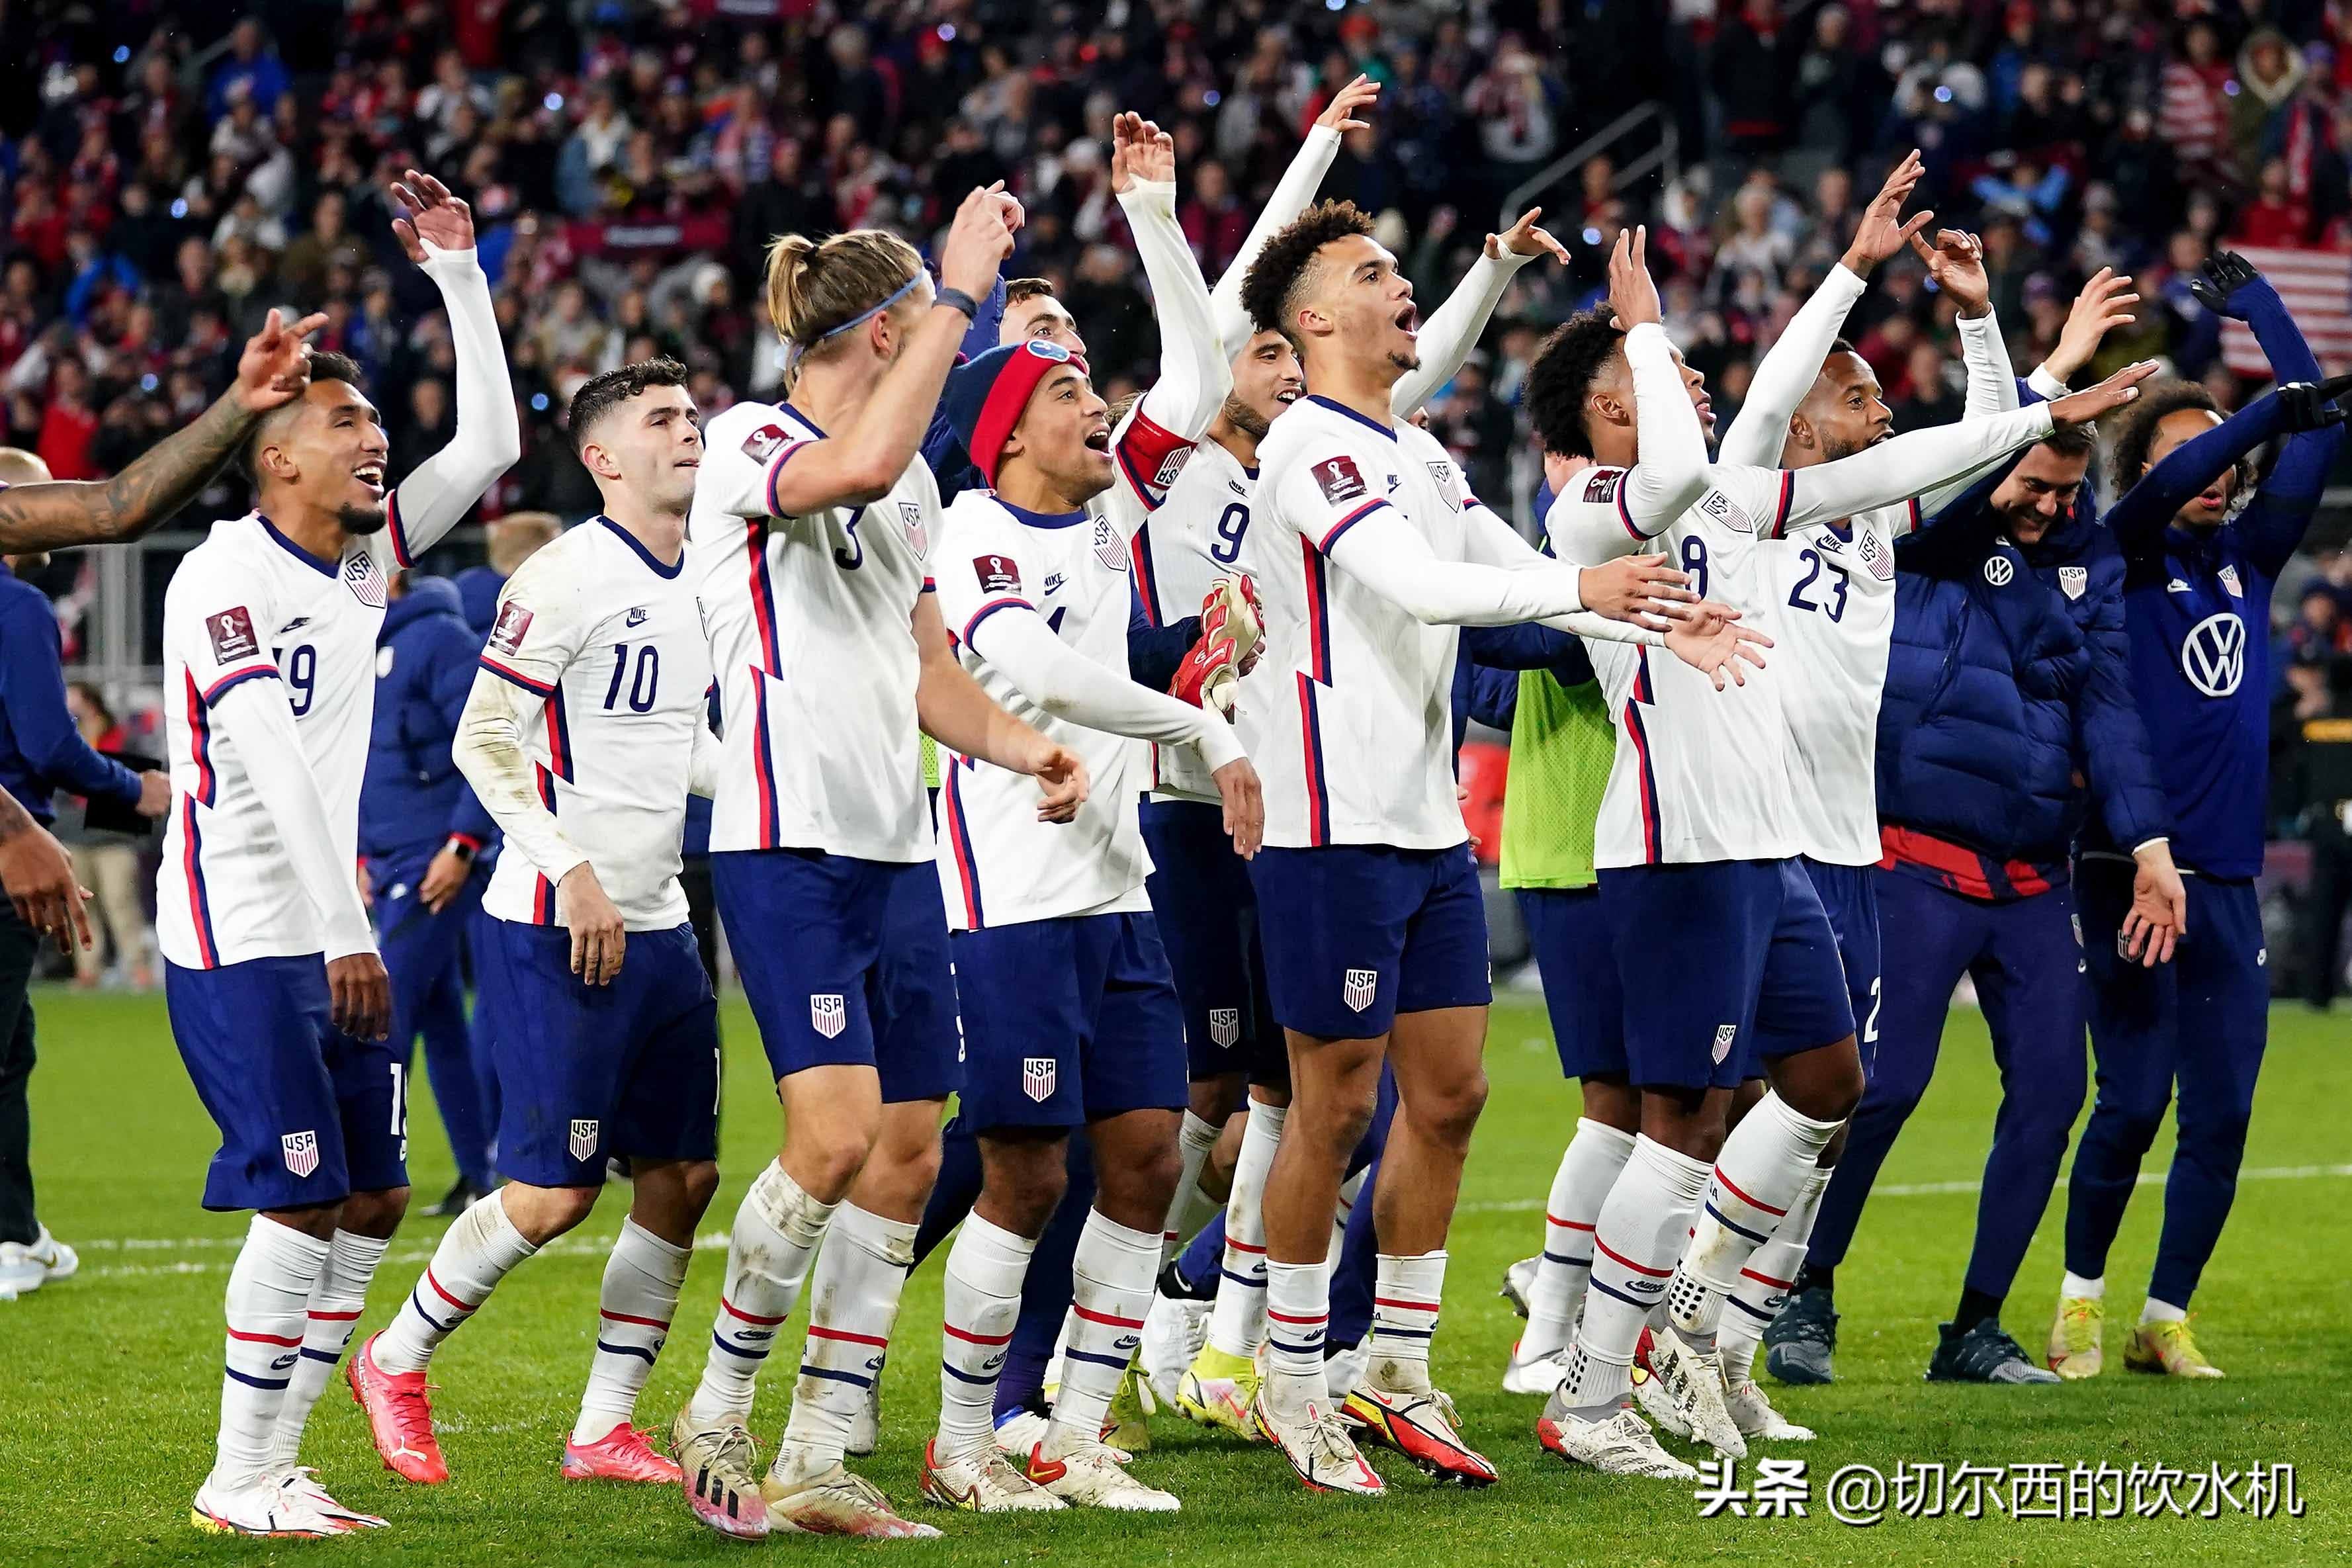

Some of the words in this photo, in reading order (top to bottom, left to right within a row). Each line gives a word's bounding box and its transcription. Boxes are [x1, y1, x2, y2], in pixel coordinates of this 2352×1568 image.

[1707, 496, 1727, 515] USA
[1211, 502, 1250, 563] 9
[1821, 534, 1843, 551] NIKE
[1860, 536, 1876, 562] USA
[345, 556, 370, 582] USA
[1681, 535, 1708, 601] 8
[2061, 569, 2084, 578] USA
[1788, 548, 1849, 623] 23
[630, 607, 646, 620] NIKE
[272, 644, 316, 716] 9
[603, 644, 659, 713] 10
[1348, 971, 1375, 988] USA
[814, 998, 841, 1013] USA
[1211, 1010, 1236, 1025] USA
[1719, 1027, 1734, 1041] USA
[1026, 1061, 1053, 1077] USA
[572, 1121, 596, 1138] USA
[285, 1133, 314, 1152] USA
